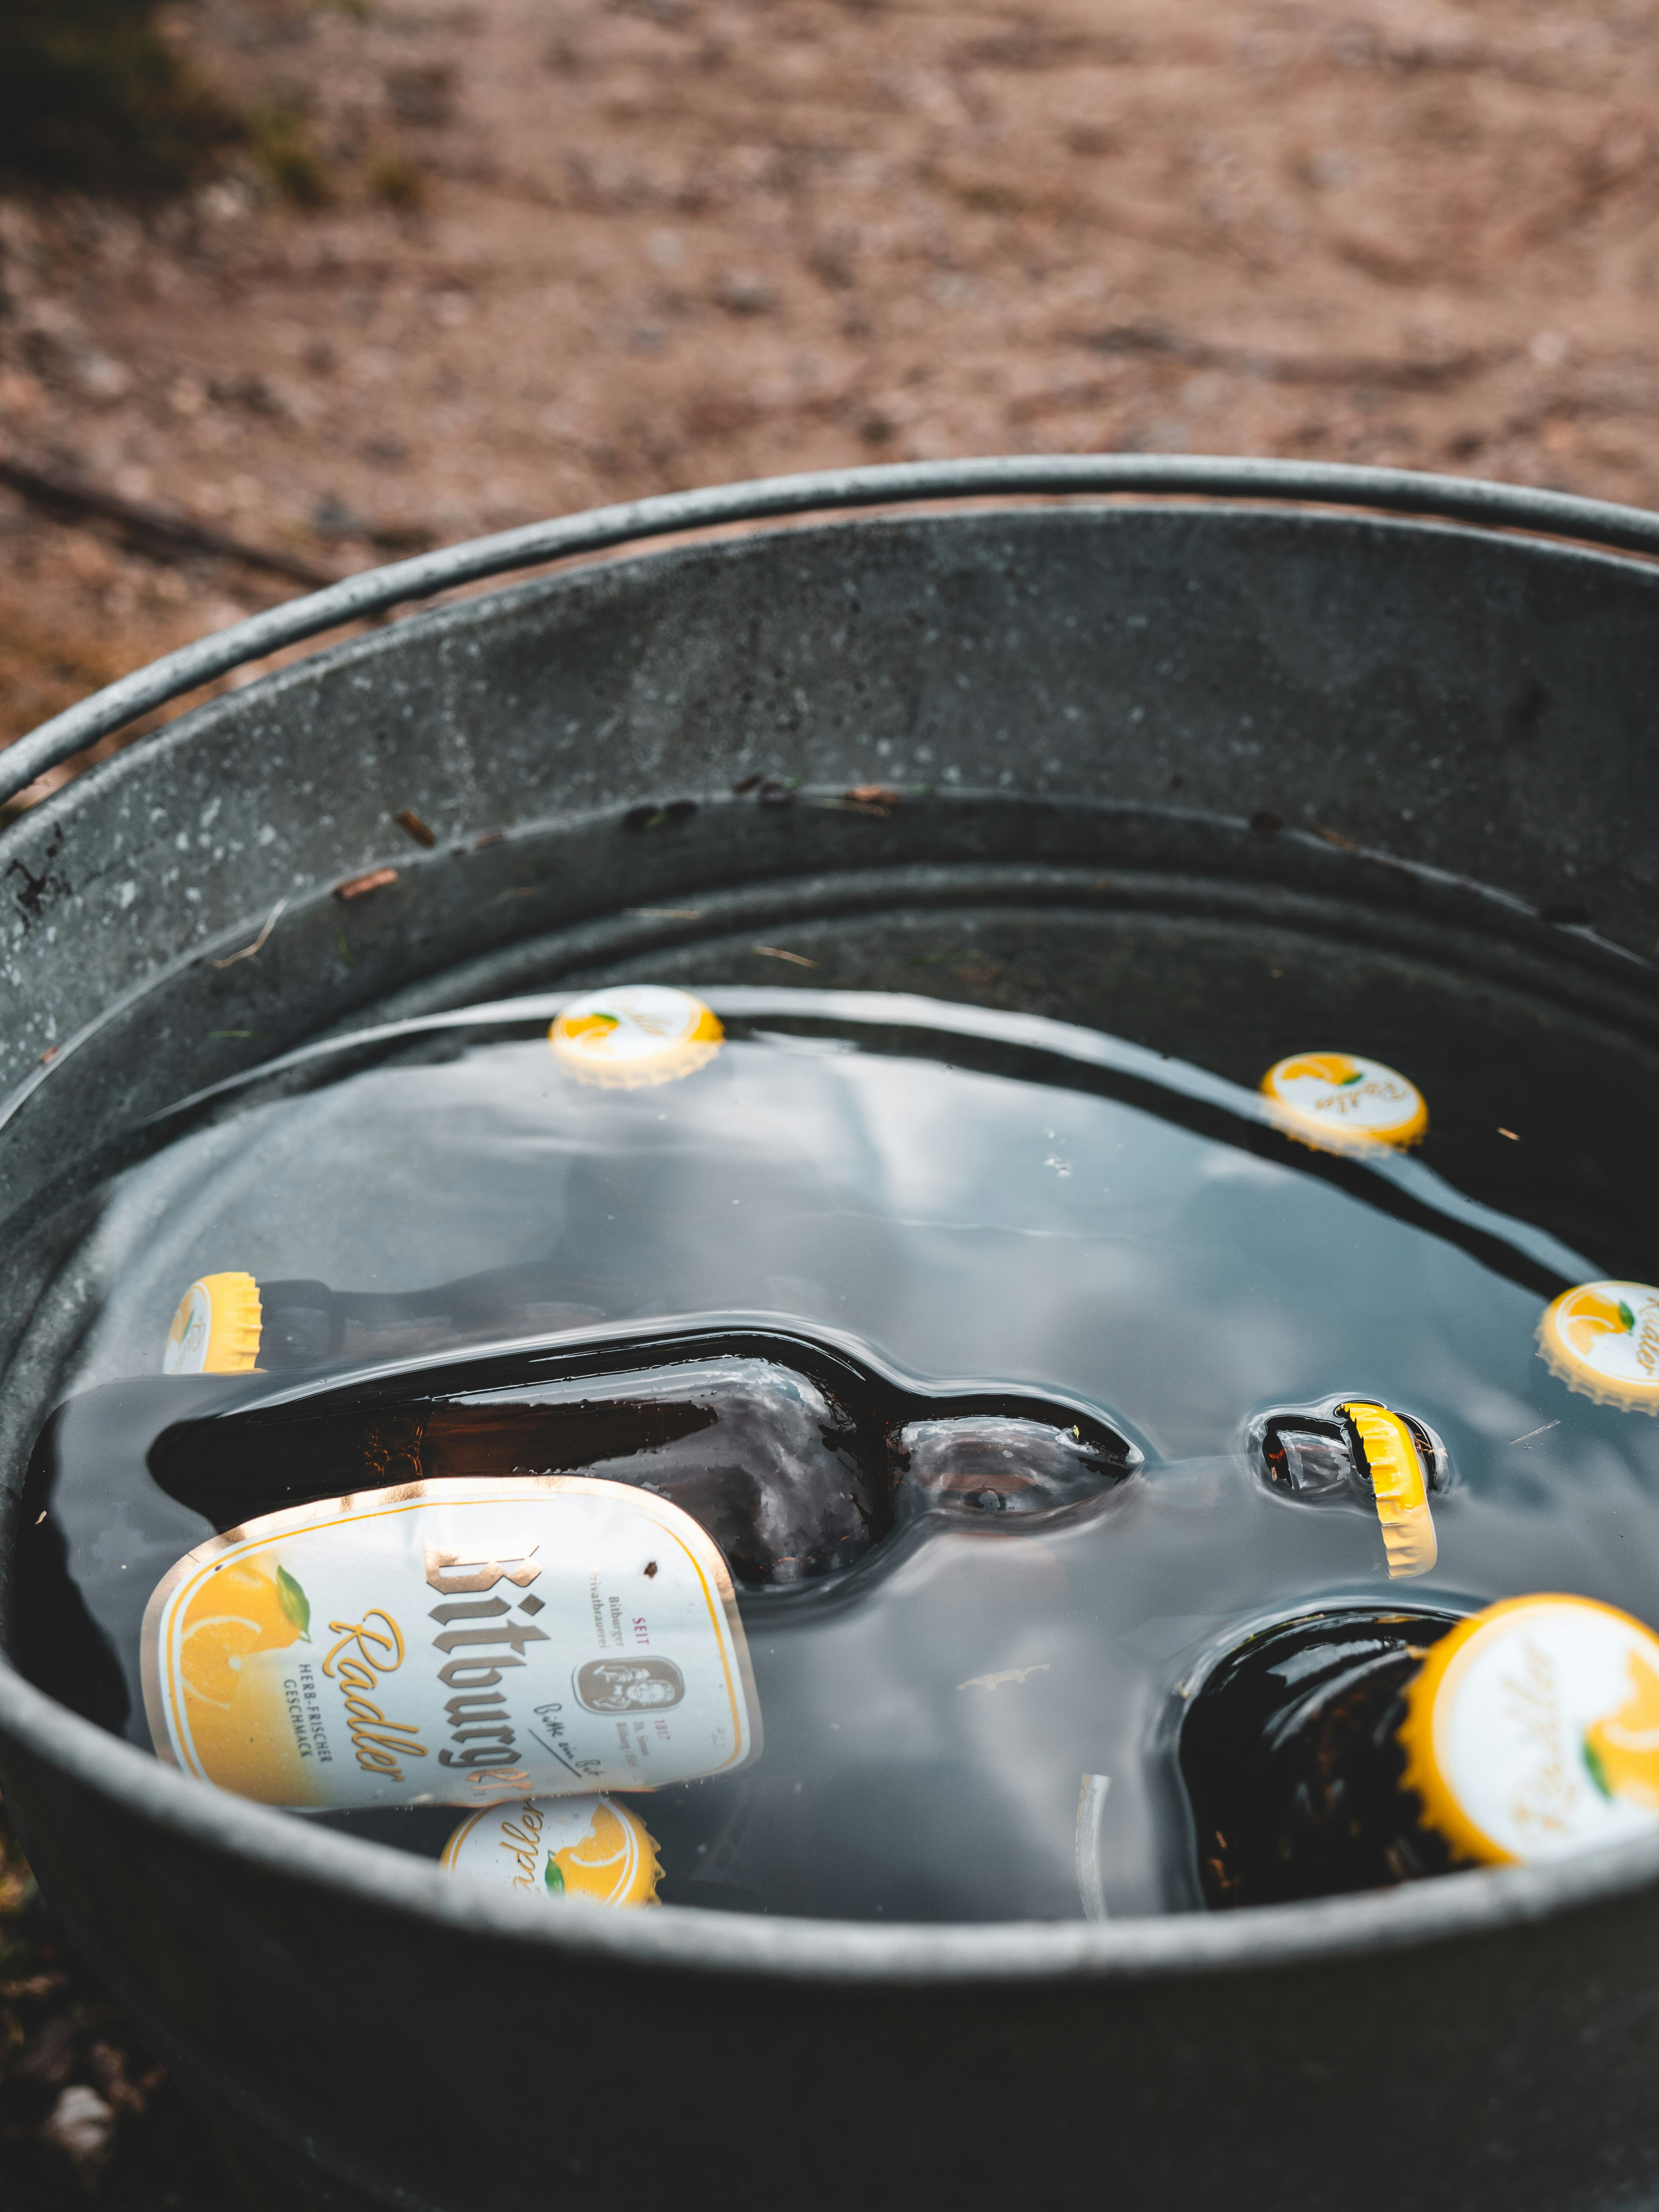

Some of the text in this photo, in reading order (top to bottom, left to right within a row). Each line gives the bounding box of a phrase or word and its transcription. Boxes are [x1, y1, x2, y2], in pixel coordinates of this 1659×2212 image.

[423, 1535, 551, 1790] Bitburger
[608, 1596, 624, 1648] Bitburger
[632, 1617, 649, 1645] SEIT
[284, 1679, 314, 1758] GESCHMACK
[299, 1663, 333, 1763] HERB-FRISCHER
[322, 1608, 429, 1782] Radler
[653, 1719, 671, 1740] 1817
[498, 1798, 544, 1895] adler
